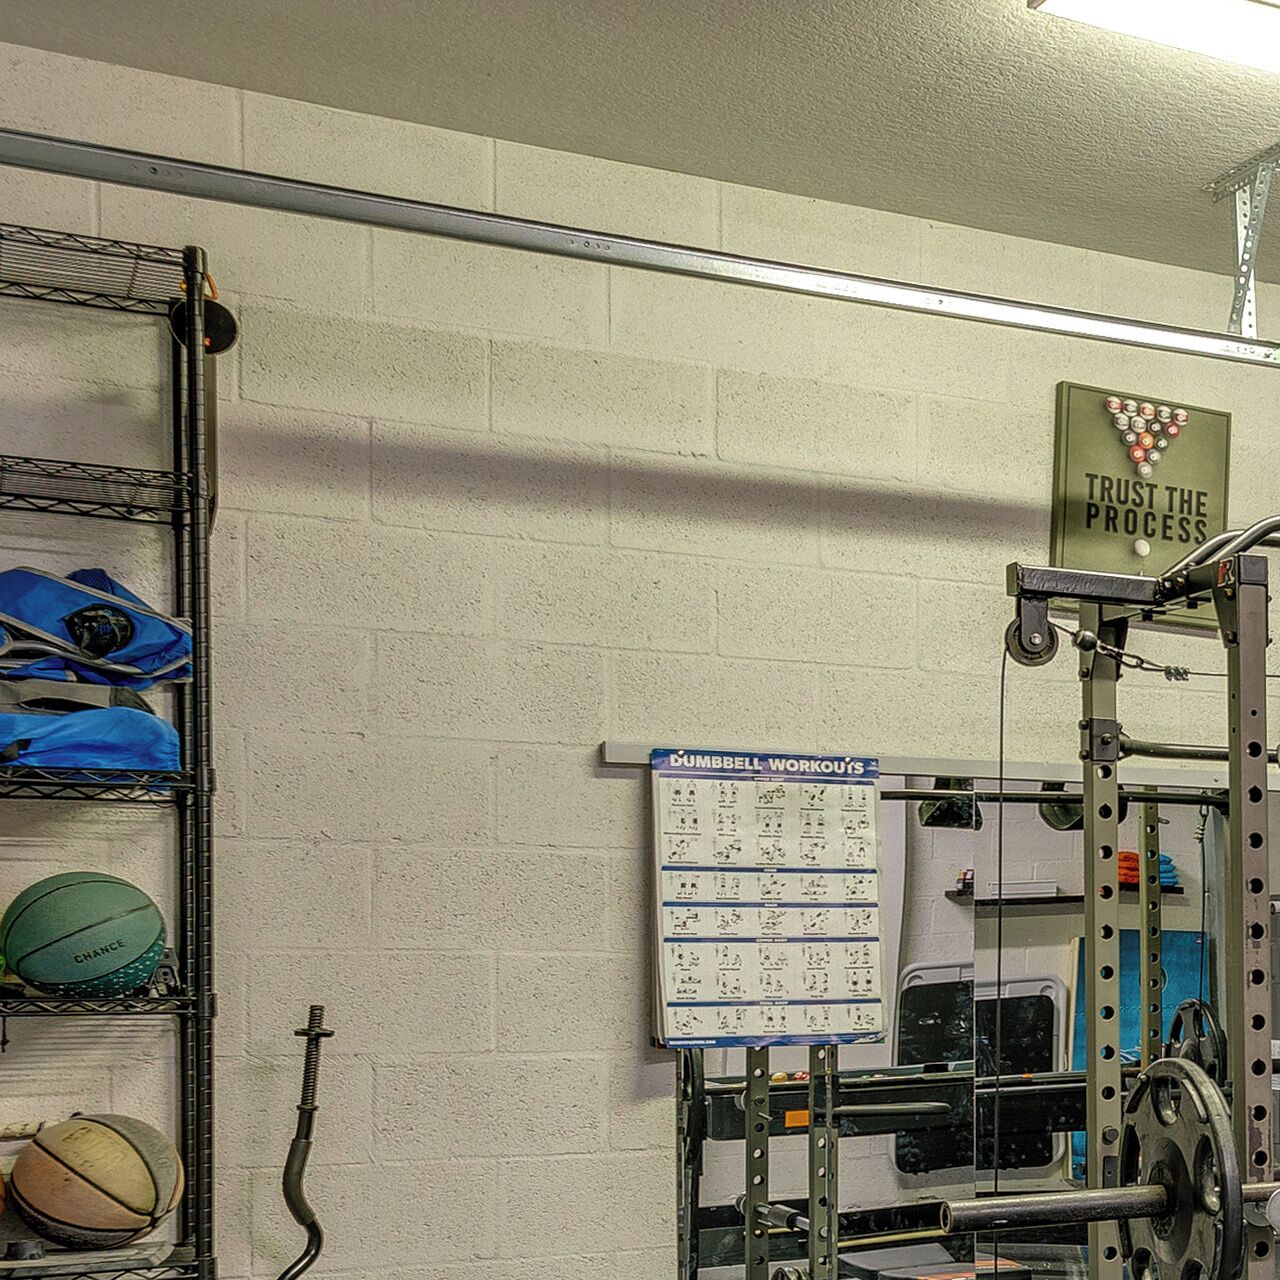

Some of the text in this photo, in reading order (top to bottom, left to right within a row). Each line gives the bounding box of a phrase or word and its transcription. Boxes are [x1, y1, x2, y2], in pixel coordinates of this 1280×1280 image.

[1085, 473, 1208, 517] TRUST THE
[1085, 502, 1207, 545] PROCESS
[670, 754, 865, 774] DUMBBELL WORKOUTS
[73, 938, 126, 964] CHANCE
